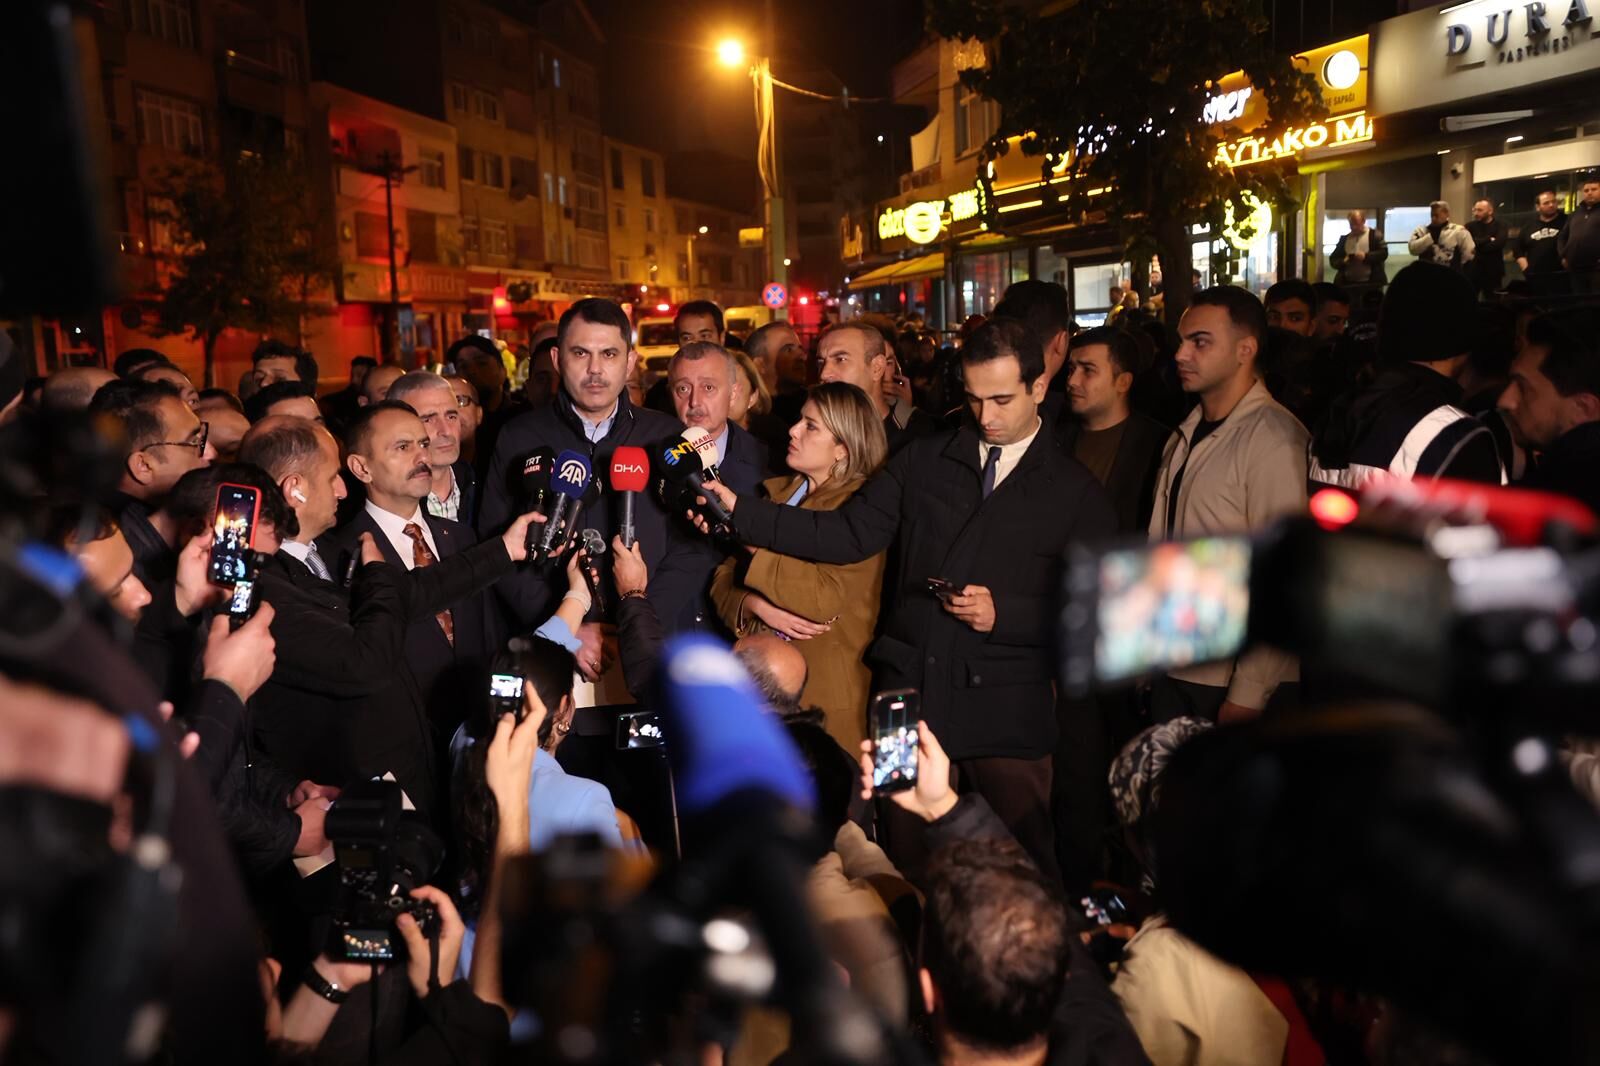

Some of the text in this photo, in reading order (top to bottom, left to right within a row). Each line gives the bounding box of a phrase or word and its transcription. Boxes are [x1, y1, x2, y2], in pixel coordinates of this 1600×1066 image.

[525, 455, 542, 467] TRT
[614, 463, 644, 473] DHA
[559, 463, 584, 488] AA
